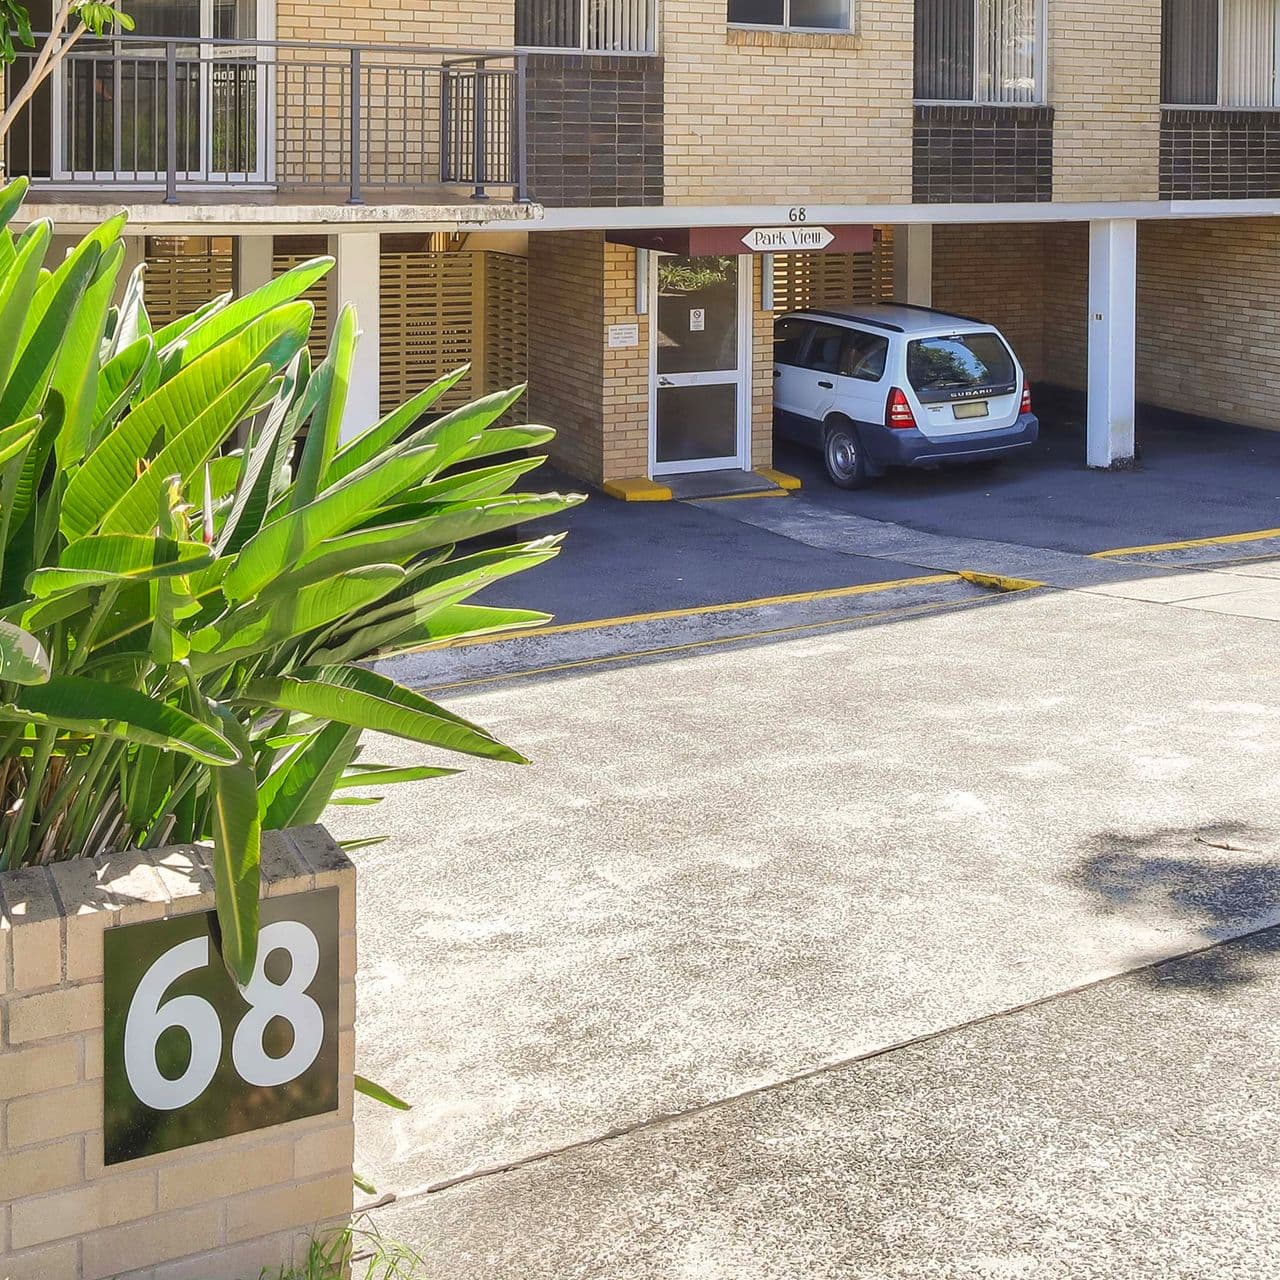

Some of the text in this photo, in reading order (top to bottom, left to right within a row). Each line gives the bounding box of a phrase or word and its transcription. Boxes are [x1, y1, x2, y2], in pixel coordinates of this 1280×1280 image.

[788, 207, 806, 222] 68
[754, 228, 821, 246] Park View
[950, 388, 993, 398] SUBARU
[124, 921, 324, 1110] 68
